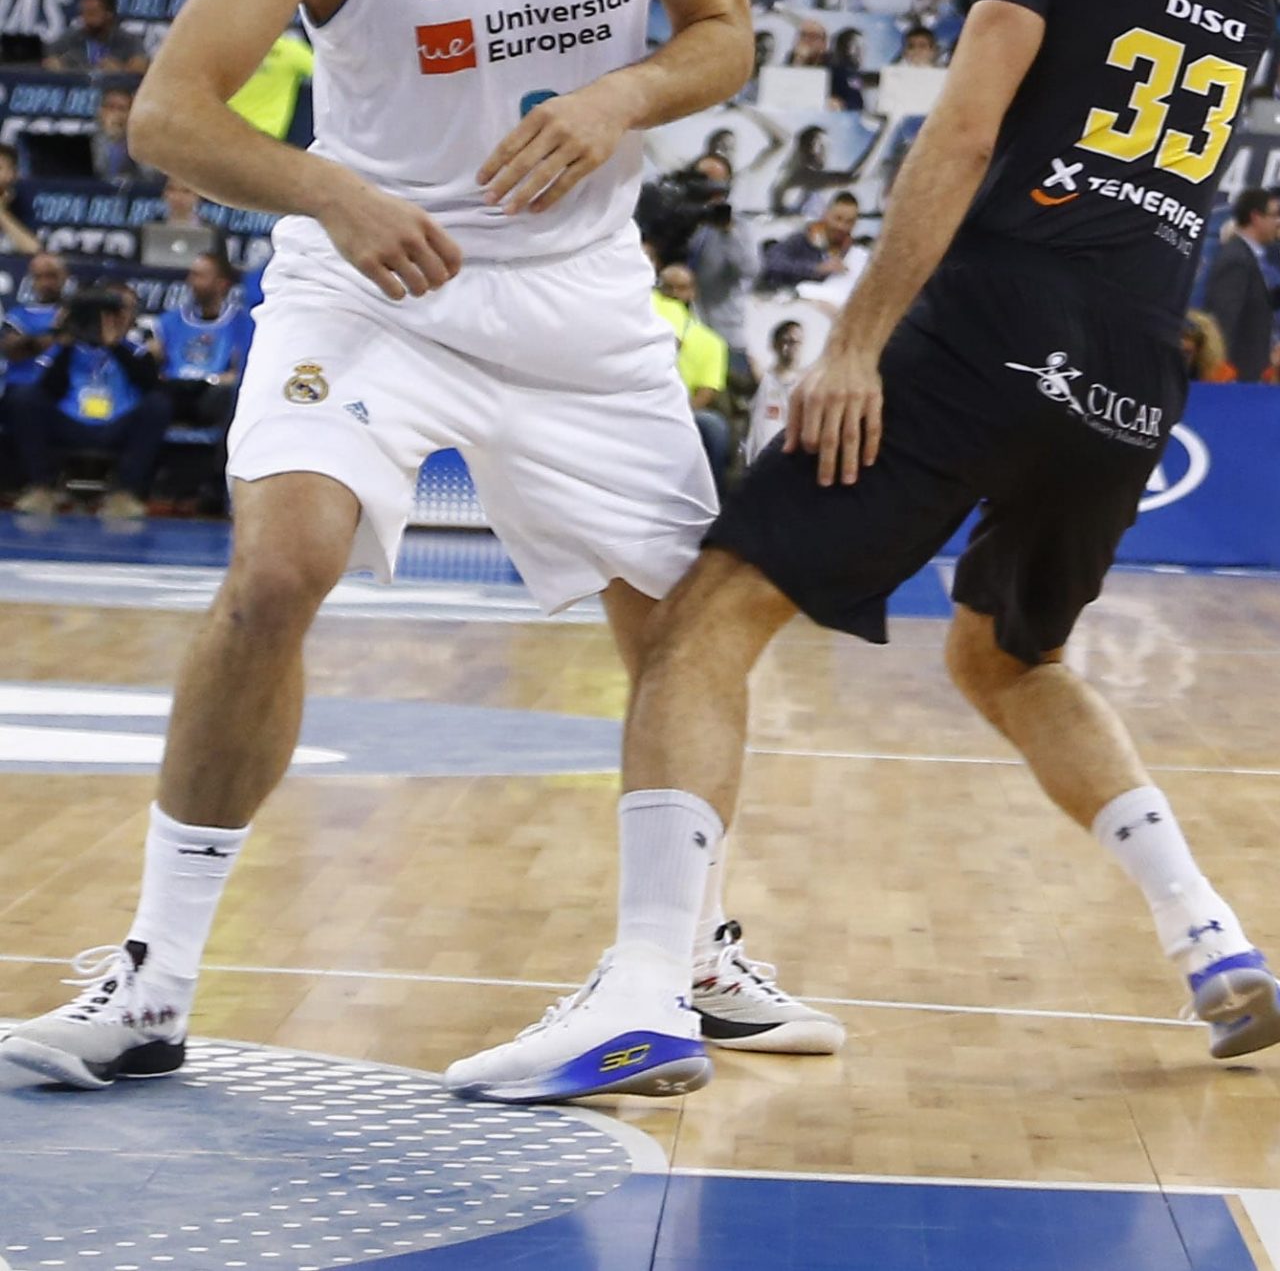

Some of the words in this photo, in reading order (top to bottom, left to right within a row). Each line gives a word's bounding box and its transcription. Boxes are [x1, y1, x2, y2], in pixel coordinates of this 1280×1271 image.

[487, 22, 613, 63] Europea
[1074, 27, 1248, 185] 33
[1087, 177, 1204, 239] TENERIFE
[1087, 383, 1163, 437] CICAR
